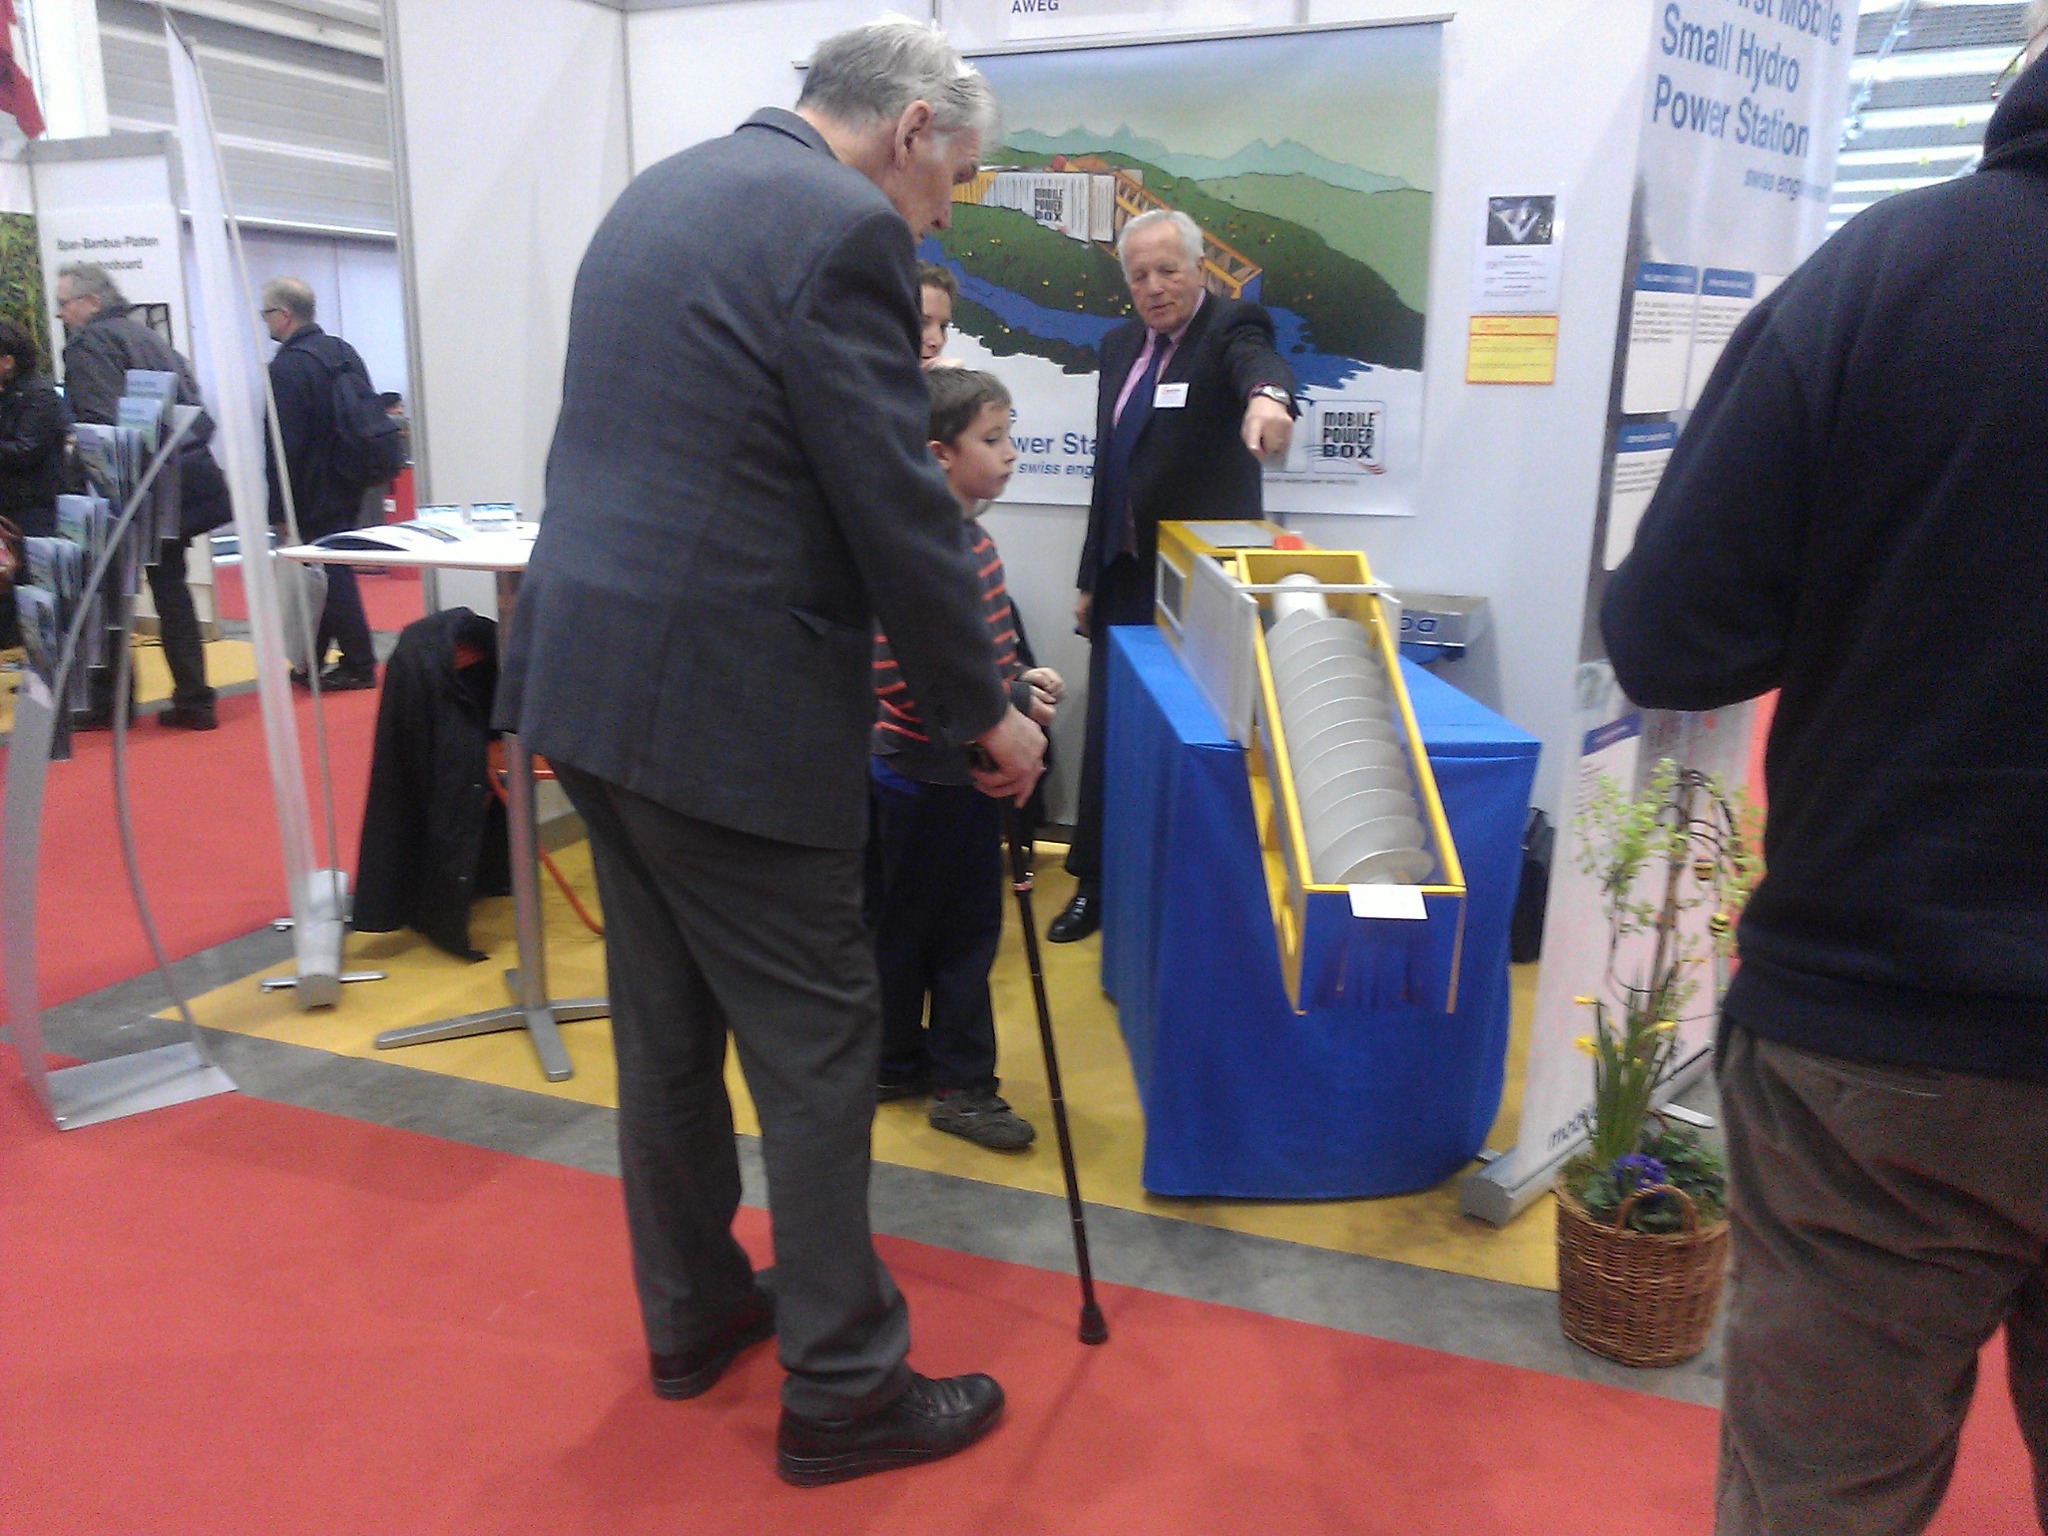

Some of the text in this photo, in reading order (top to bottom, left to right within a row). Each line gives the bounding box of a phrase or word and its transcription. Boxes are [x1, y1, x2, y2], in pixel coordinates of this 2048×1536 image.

[1012, 0, 1059, 13] AWEG
[1661, 3, 1800, 93] Small Hydro
[1653, 74, 1810, 157] Power Station
[1324, 411, 1376, 427] MOBILE
[1009, 431, 1098, 456] wer Sta
[1323, 427, 1375, 444] POWER
[1323, 443, 1374, 459] BOX
[1018, 461, 1096, 479] swiss eng
